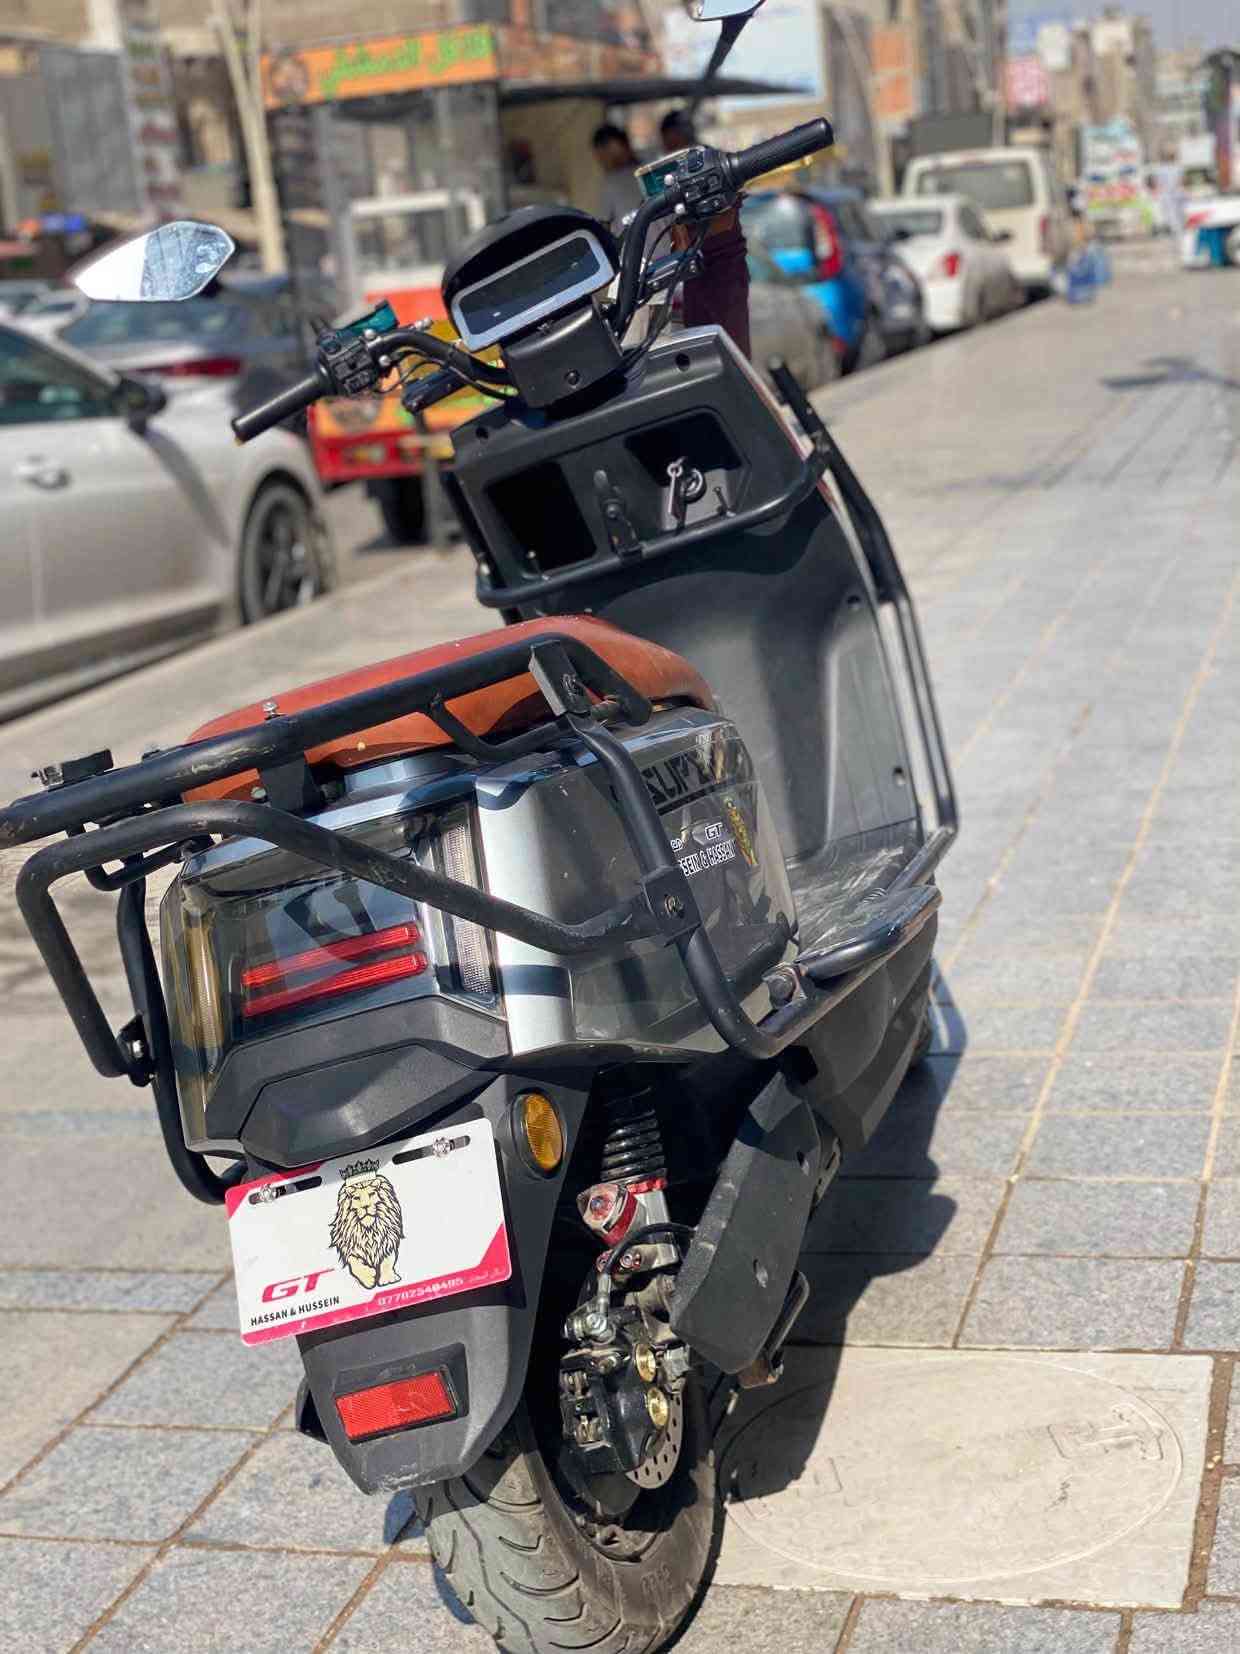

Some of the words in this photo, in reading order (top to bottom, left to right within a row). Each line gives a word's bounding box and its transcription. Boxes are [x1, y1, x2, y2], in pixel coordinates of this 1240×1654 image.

[262, 1268, 335, 1302] GT
[250, 1309, 288, 1326] HASSAN
[289, 1307, 297, 1316] &
[298, 1296, 340, 1313] HUSSEIN
